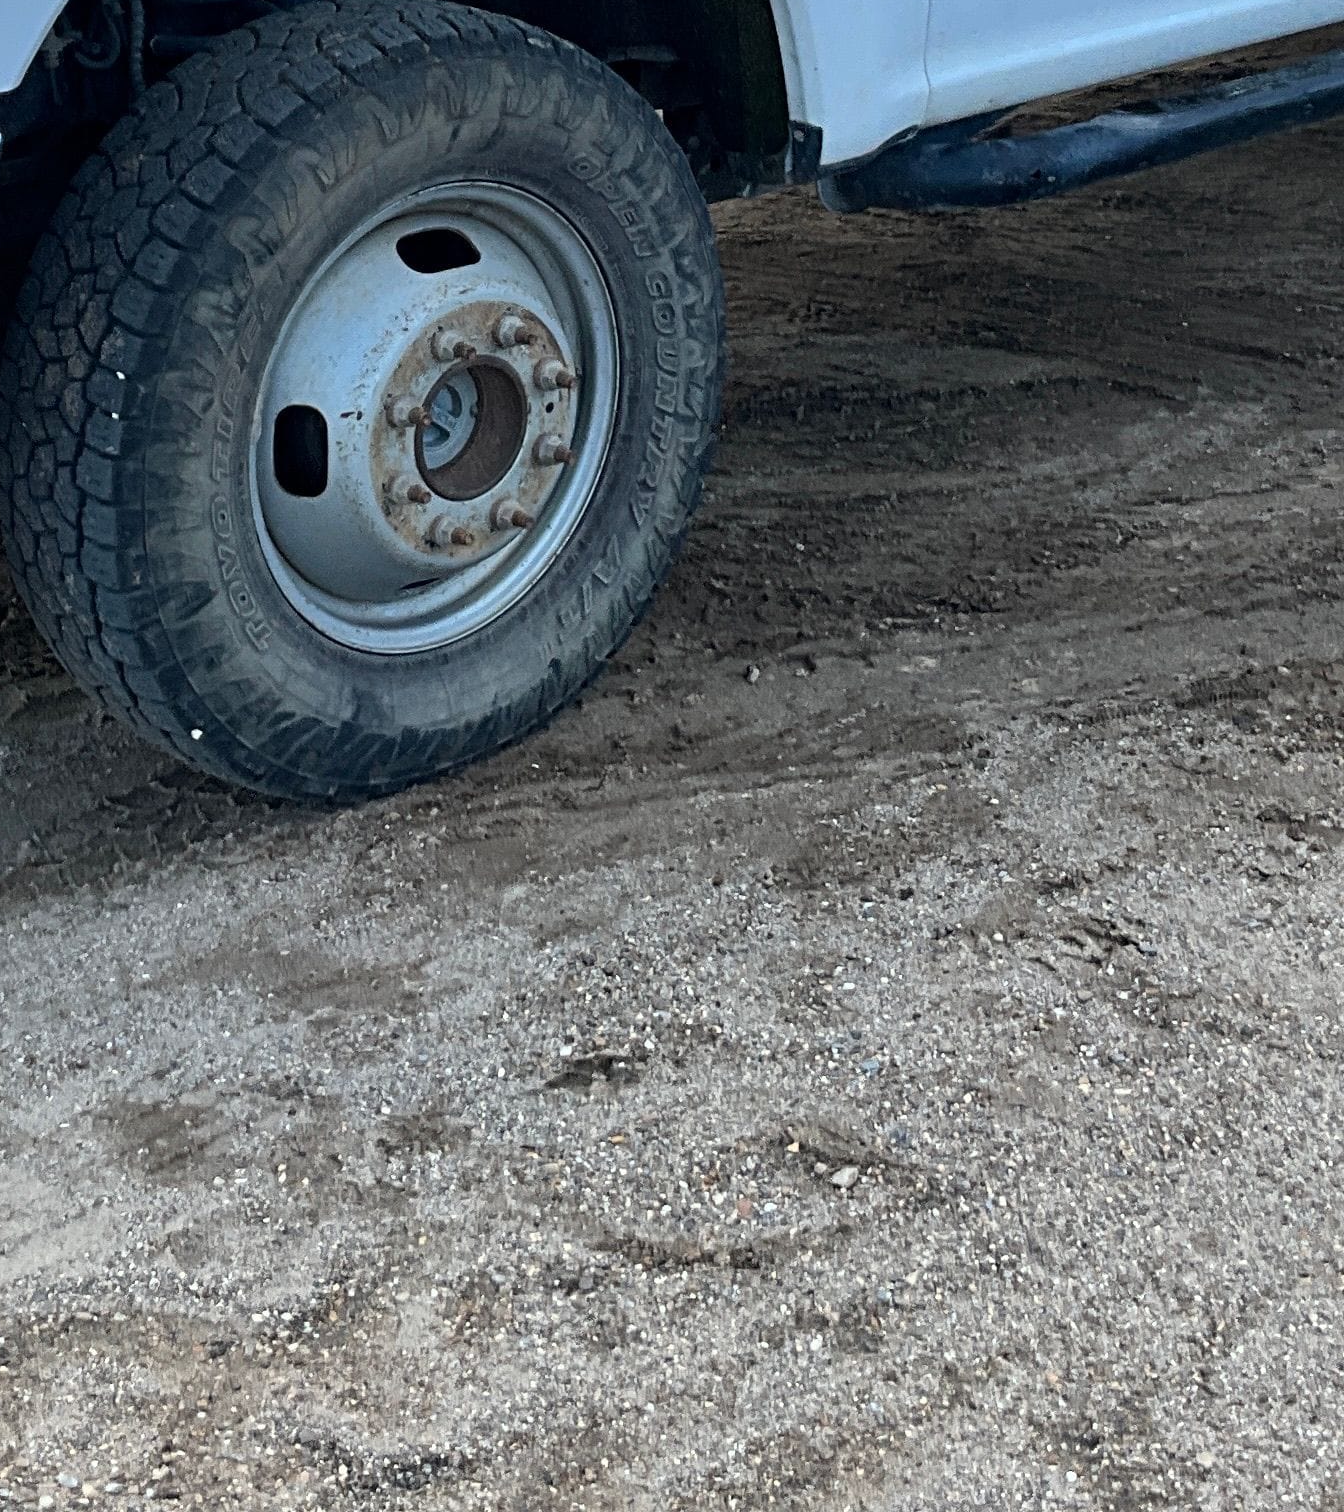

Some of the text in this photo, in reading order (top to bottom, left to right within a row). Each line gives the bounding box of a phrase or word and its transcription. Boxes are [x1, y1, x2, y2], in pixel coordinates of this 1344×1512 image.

[567, 155, 657, 258] OPEN
[632, 269, 678, 526] COUNTRY
[212, 496, 273, 651] TOYO
